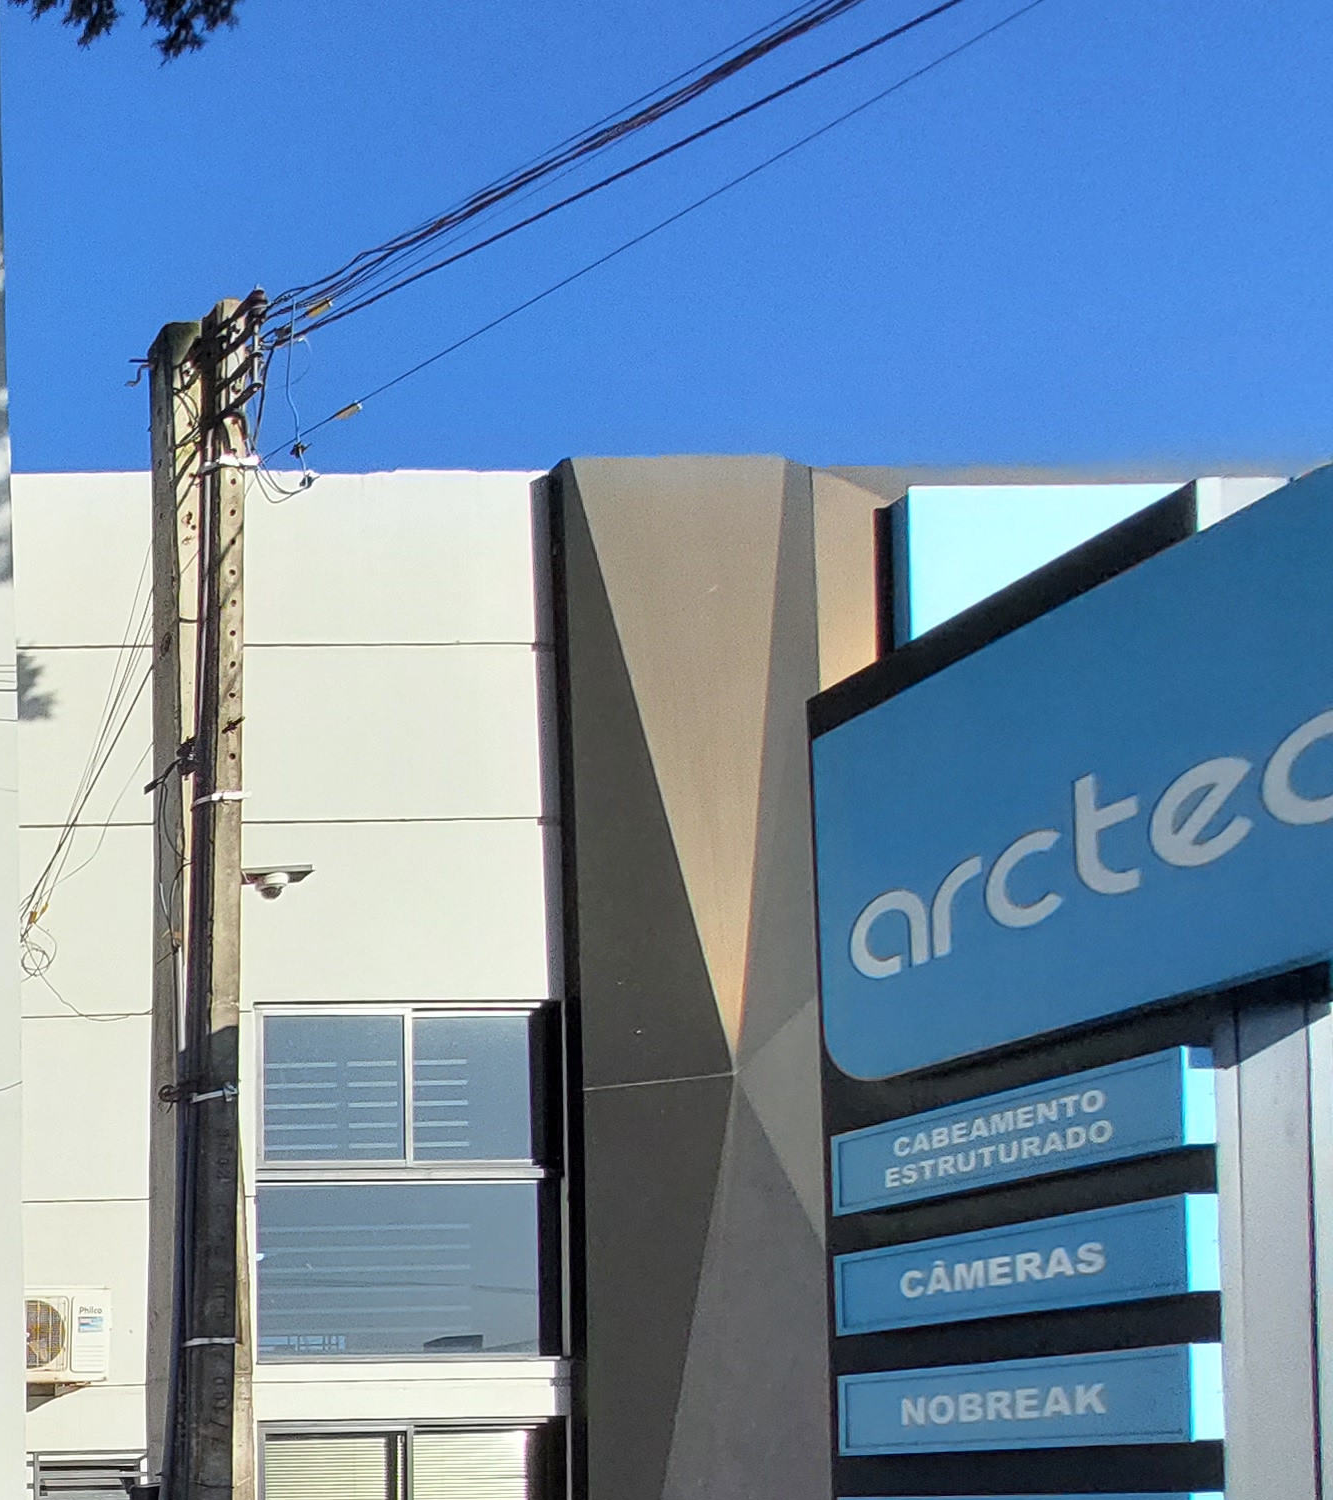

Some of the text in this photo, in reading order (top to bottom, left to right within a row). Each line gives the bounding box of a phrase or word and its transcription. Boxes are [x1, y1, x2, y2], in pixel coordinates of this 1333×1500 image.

[892, 1089, 1107, 1159] CABEAMENTO
[884, 1119, 1115, 1189] ESTRUTURADO
[900, 1242, 1107, 1299] CÂMERAS
[78, 1305, 103, 1315] Philco
[900, 1383, 1107, 1427] NOBREAK
